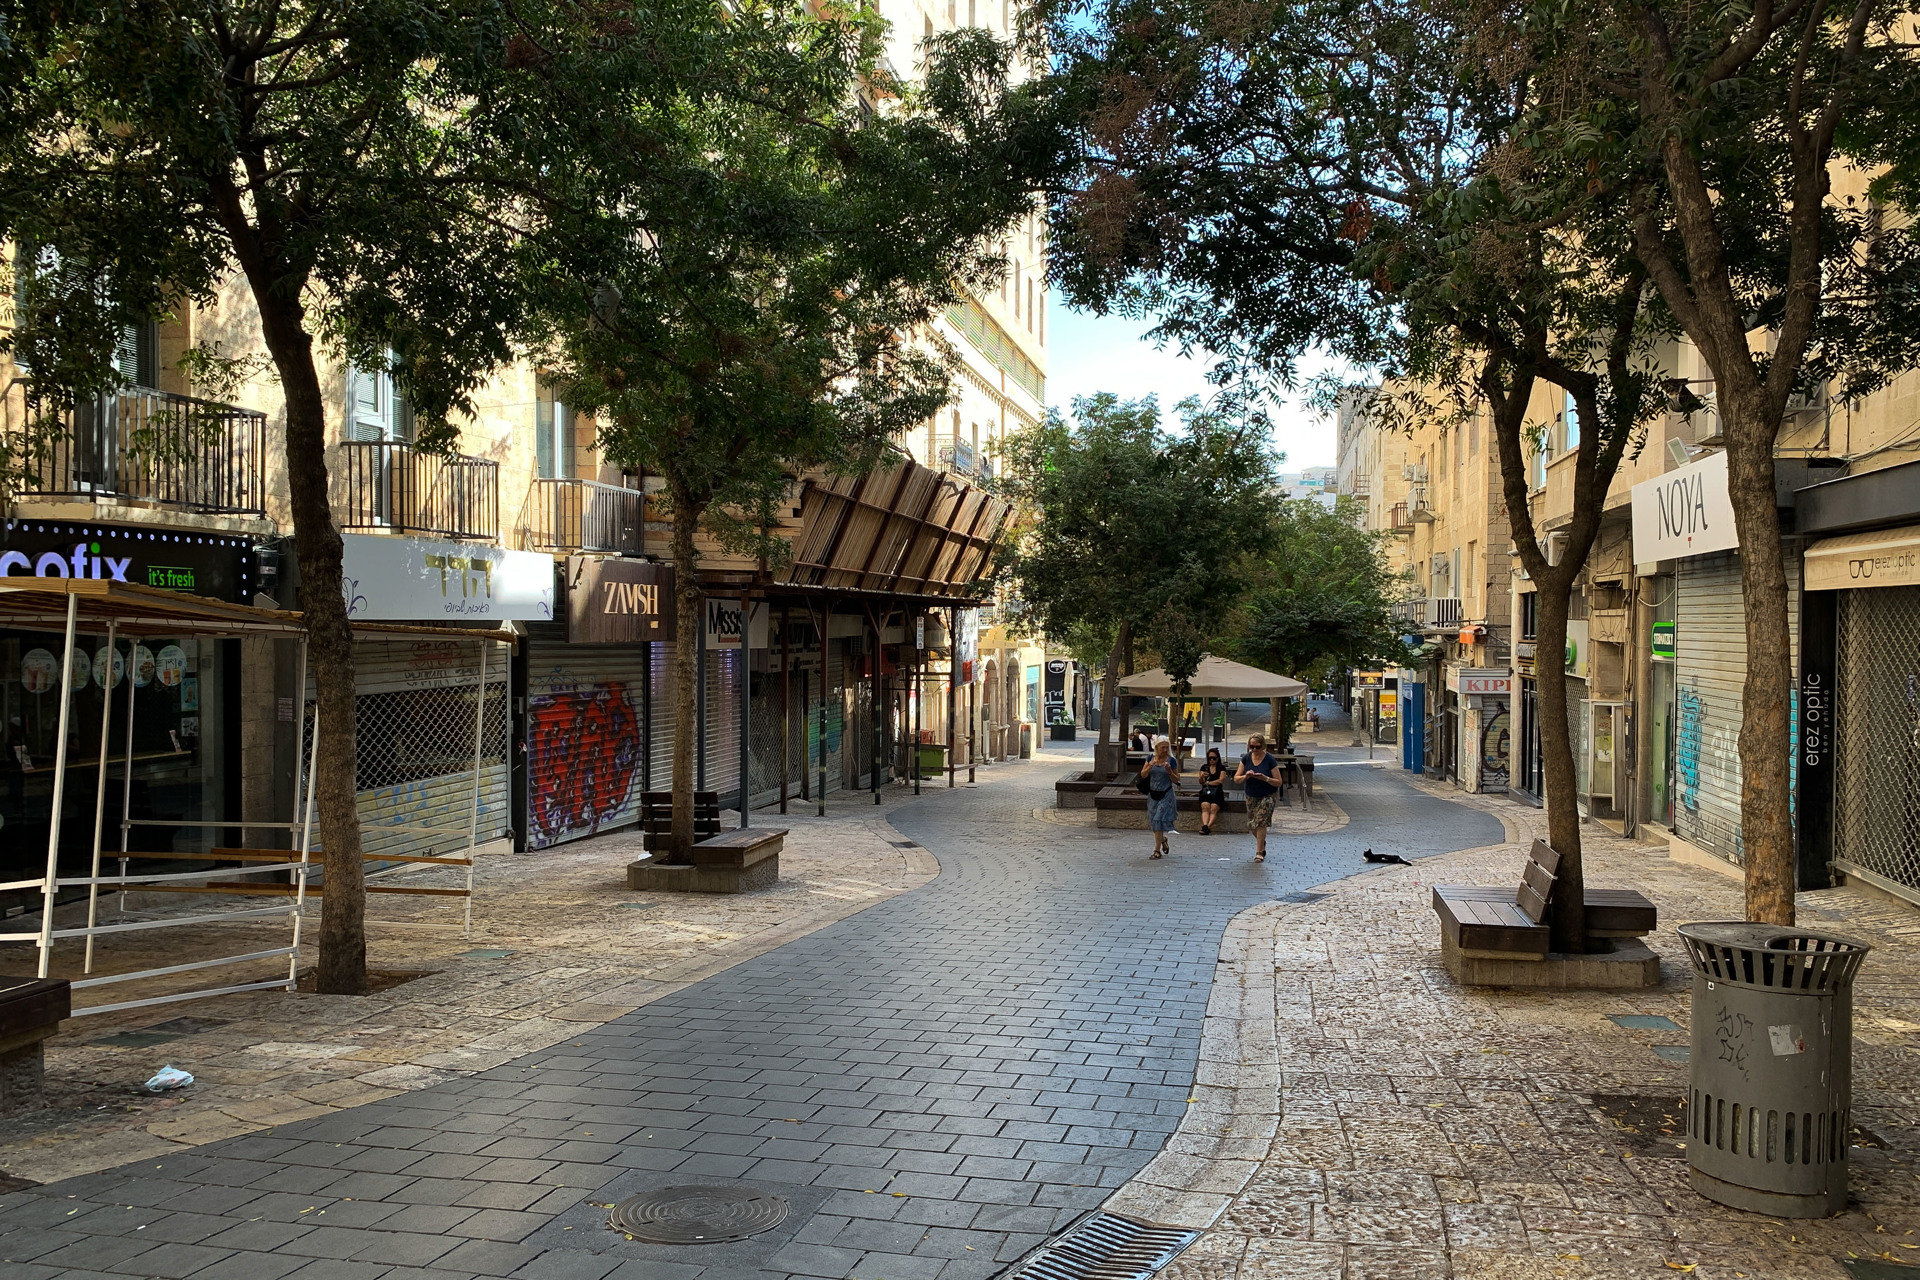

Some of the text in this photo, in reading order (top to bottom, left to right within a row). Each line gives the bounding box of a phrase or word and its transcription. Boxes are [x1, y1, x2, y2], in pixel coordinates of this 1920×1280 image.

[1657, 472, 1708, 540] NOYA
[148, 570, 195, 588] it's fresh
[425, 552, 492, 599] הדר
[1803, 673, 1824, 766] erez optic
